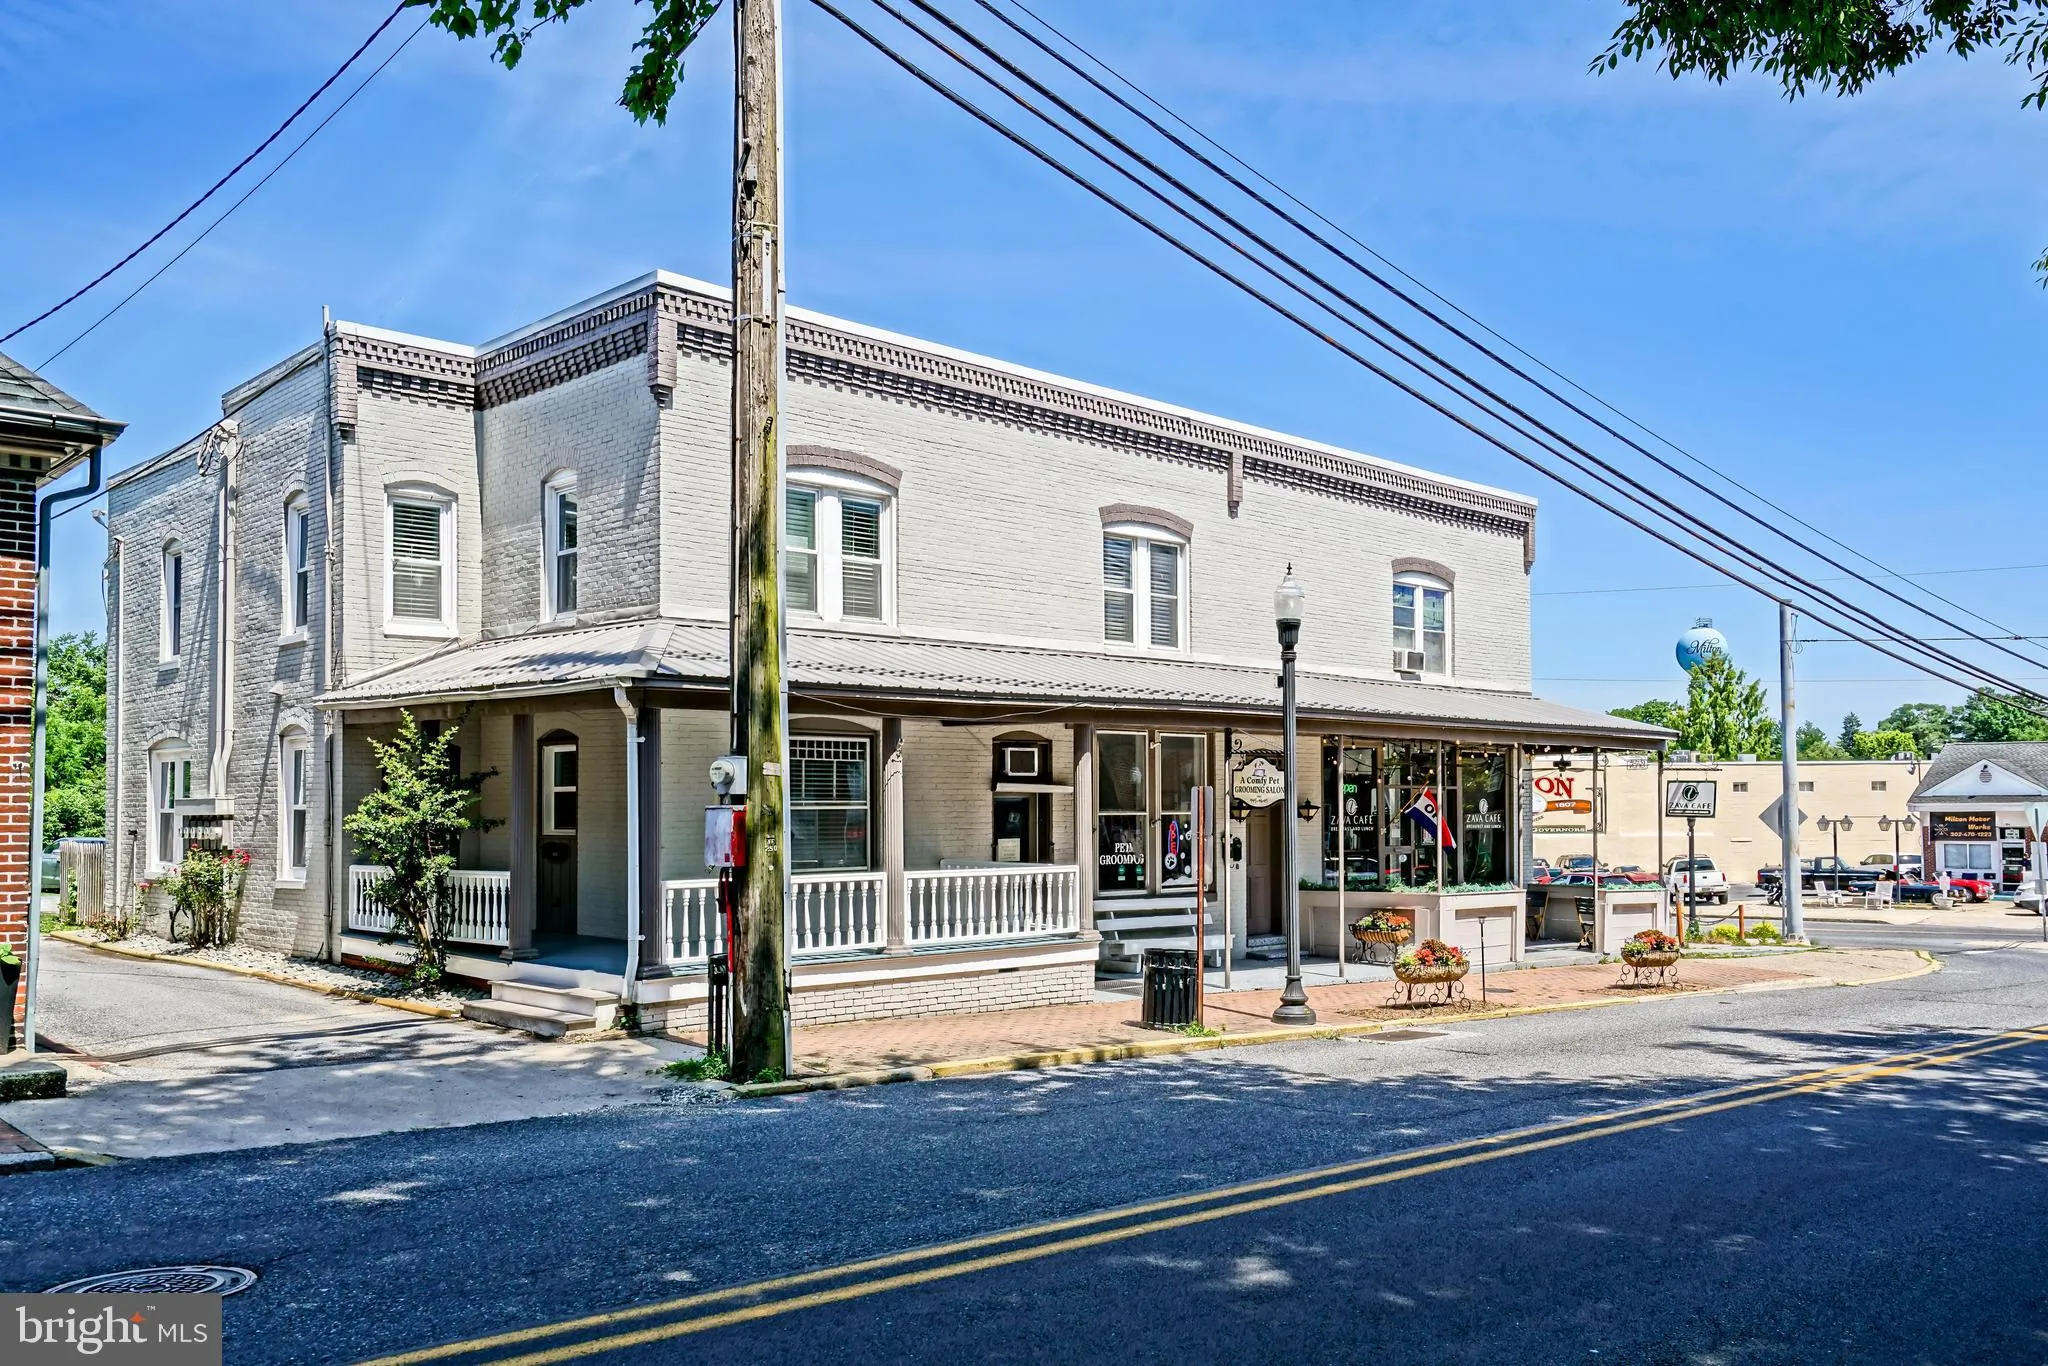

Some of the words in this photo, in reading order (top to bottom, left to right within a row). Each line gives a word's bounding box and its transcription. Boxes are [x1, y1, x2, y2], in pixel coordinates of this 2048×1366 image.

[1687, 638, 1722, 658] Milton
[1240, 776, 1245, 784] A
[1246, 776, 1267, 786] Comfy
[1268, 776, 1280, 784] Pet
[1234, 785, 1265, 794] GROOMING
[1265, 786, 1285, 794] SALON
[1466, 813, 1484, 823] ZAVA
[1484, 813, 1502, 823] CAFE
